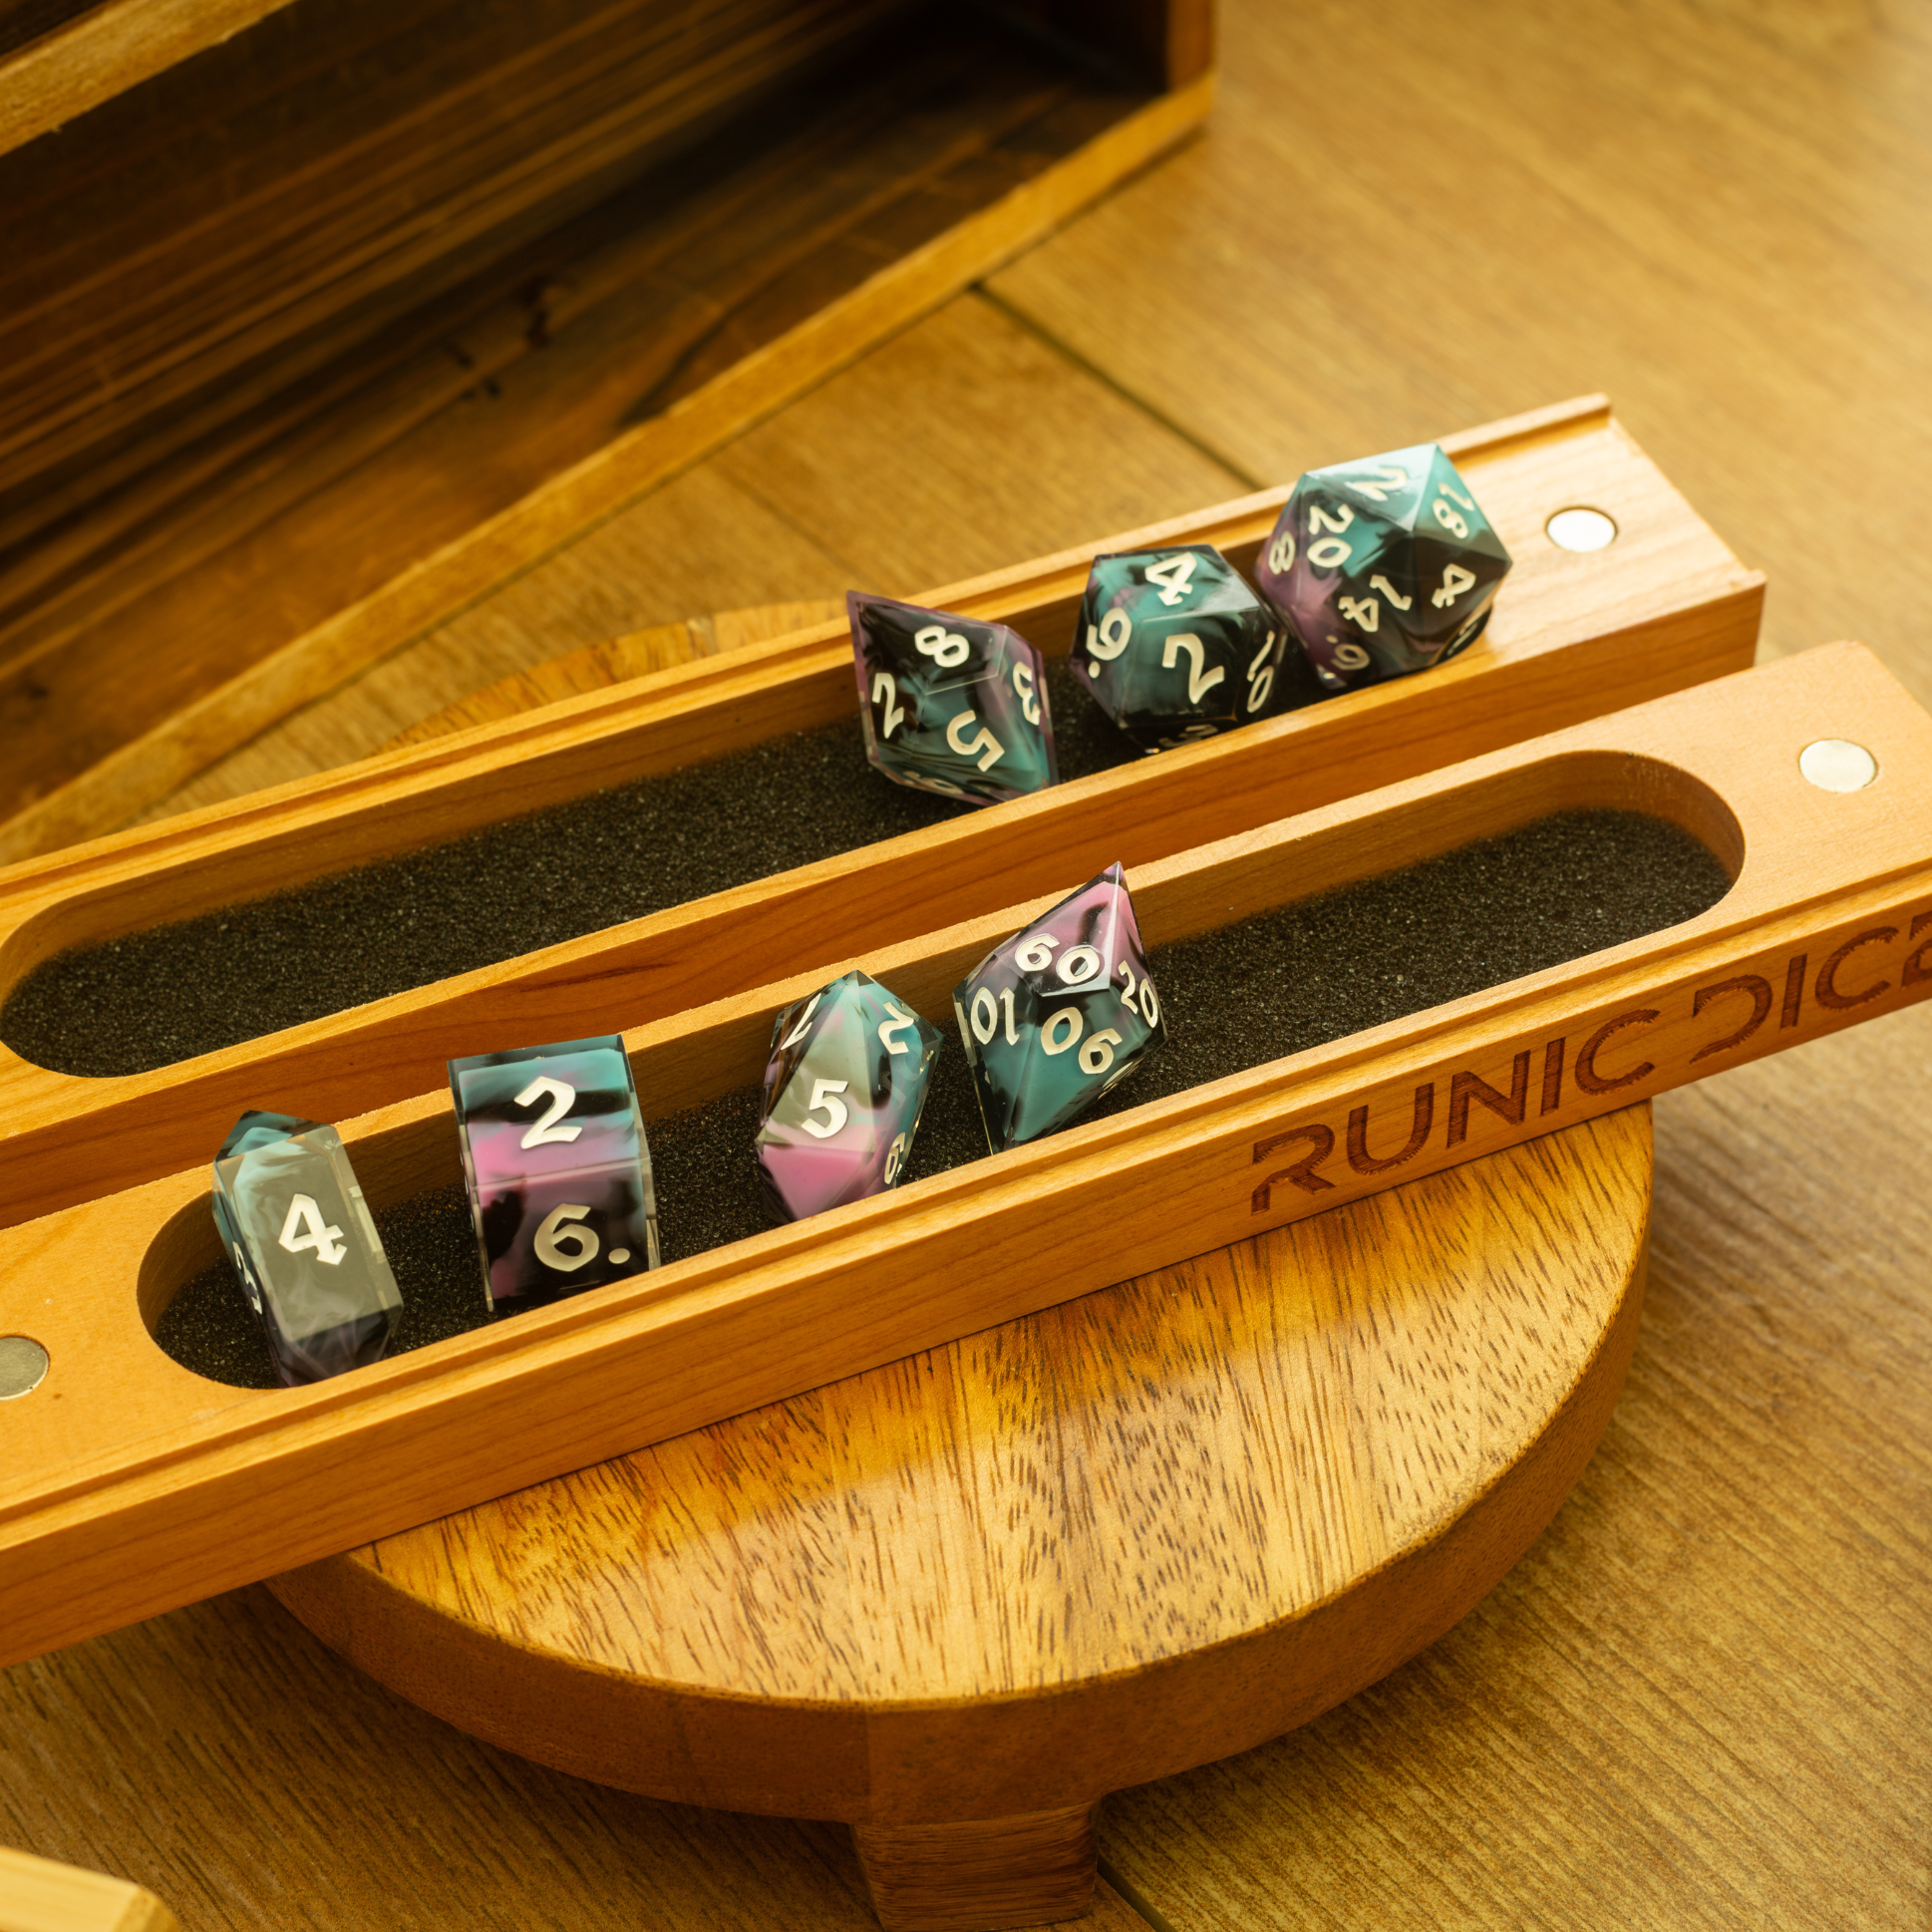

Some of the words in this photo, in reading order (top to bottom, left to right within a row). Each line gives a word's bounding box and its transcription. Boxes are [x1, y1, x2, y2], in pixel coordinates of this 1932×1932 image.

[1268, 531, 1295, 574] 8
[1307, 503, 1354, 567] 20
[1145, 552, 1197, 606] 4
[1339, 574, 1412, 632] 14
[1432, 563, 1475, 608] 4
[914, 625, 970, 667] 8
[1162, 633, 1224, 704] 2
[871, 673, 904, 739] 2
[947, 710, 1005, 773] 5
[1015, 934, 1101, 985] 60
[1119, 960, 1158, 1028] 20
[877, 1002, 914, 1055] 2
[513, 1076, 582, 1149] 2
[801, 1079, 848, 1138] 5
[1251, 1008, 1662, 1216] RUNIC
[278, 1193, 347, 1265] 4
[533, 1203, 630, 1272] 6.
